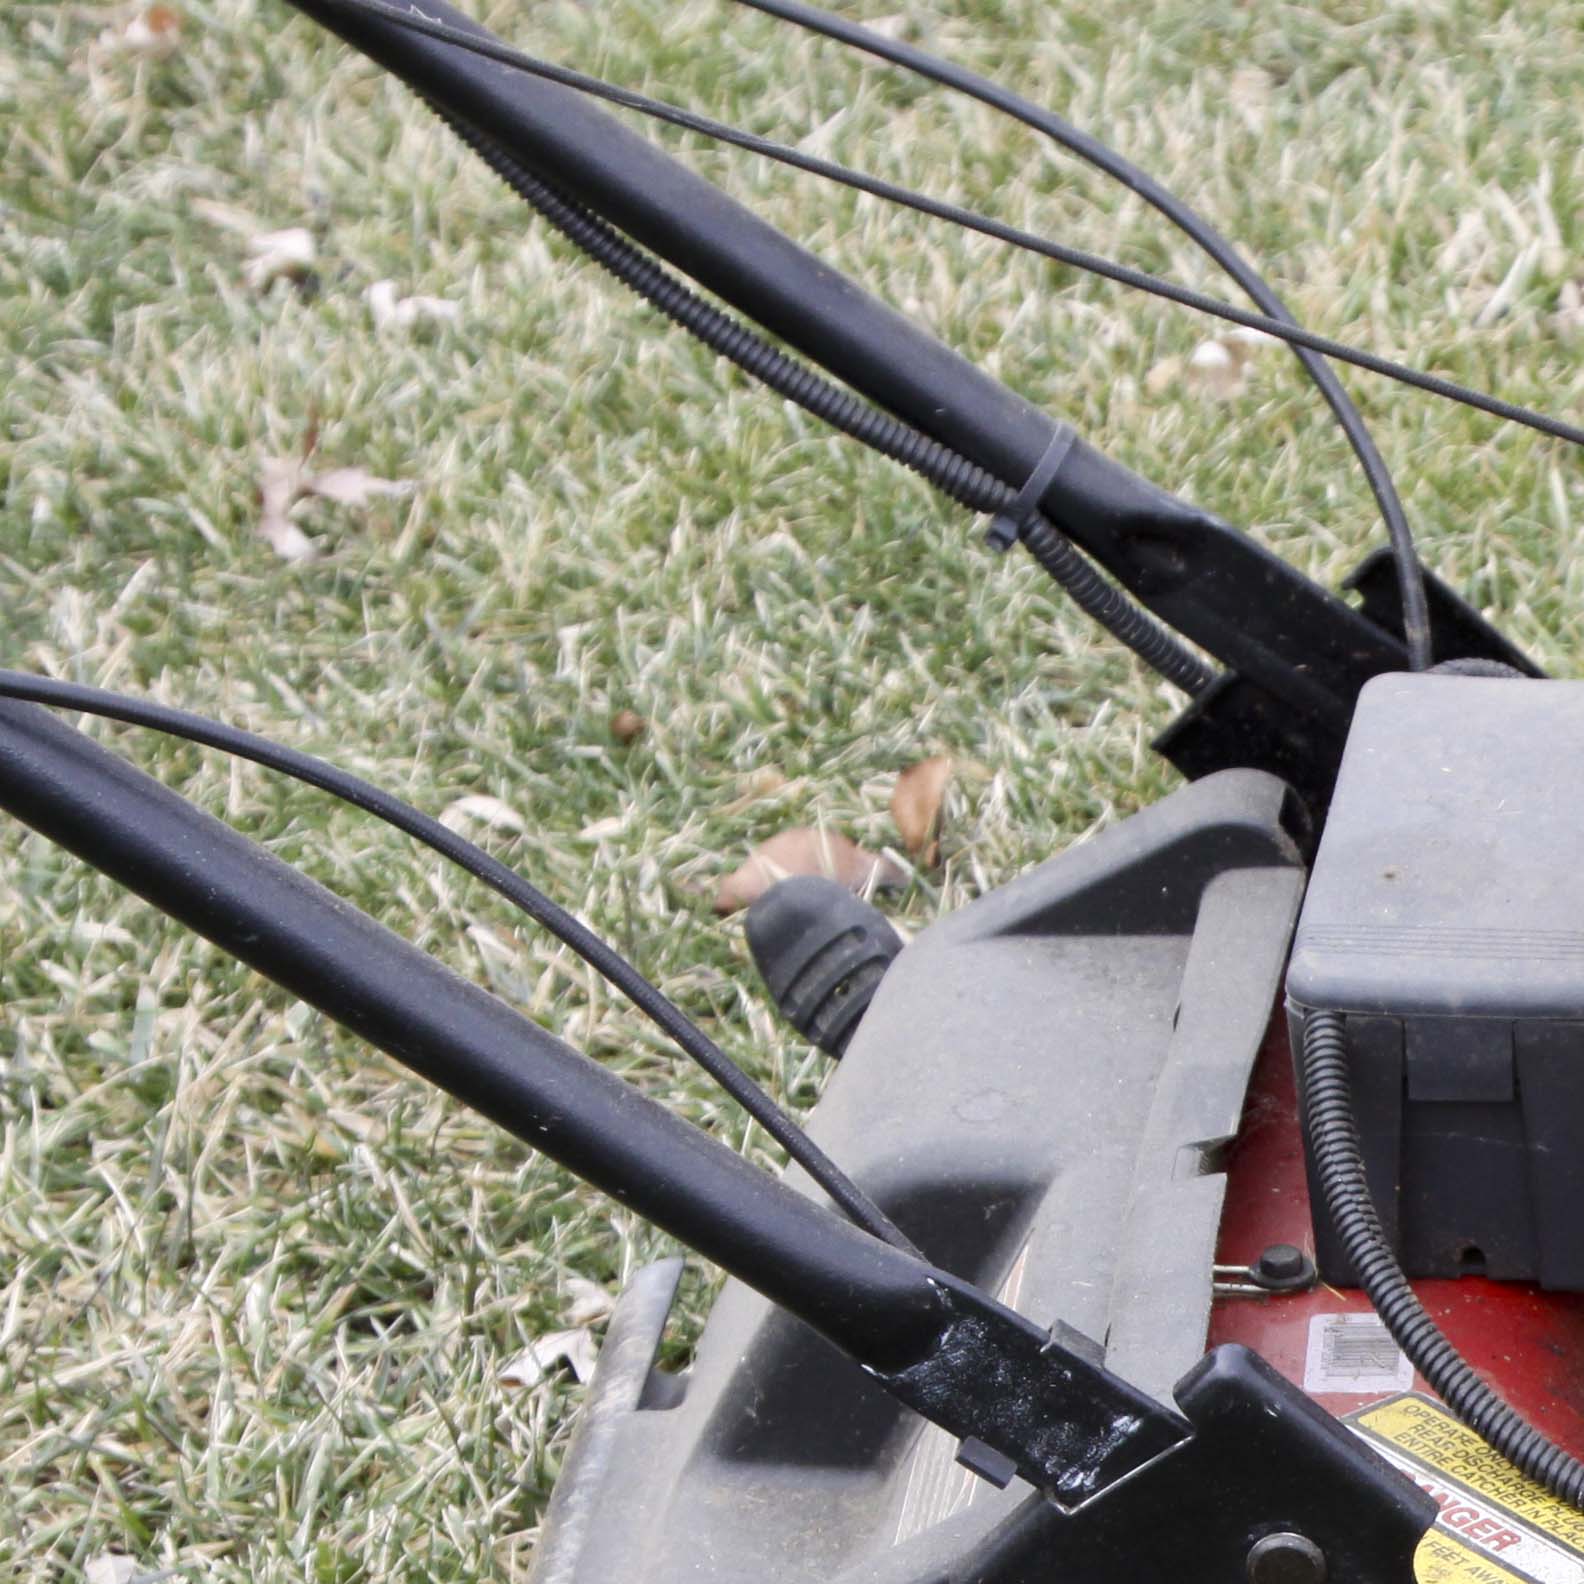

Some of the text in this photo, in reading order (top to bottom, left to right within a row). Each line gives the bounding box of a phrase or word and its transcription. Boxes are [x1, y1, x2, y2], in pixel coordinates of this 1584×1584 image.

[1403, 1404, 1479, 1447] OPERATE
[1409, 1424, 1456, 1451] REAR
[1452, 1449, 1548, 1505] DISCHARGE
[1393, 1431, 1454, 1466] ENTIRE
[1451, 1465, 1527, 1511] CATCHER
[1522, 1506, 1545, 1520] IN
[1402, 1472, 1522, 1552] NGER
[1424, 1540, 1471, 1566] FEET
